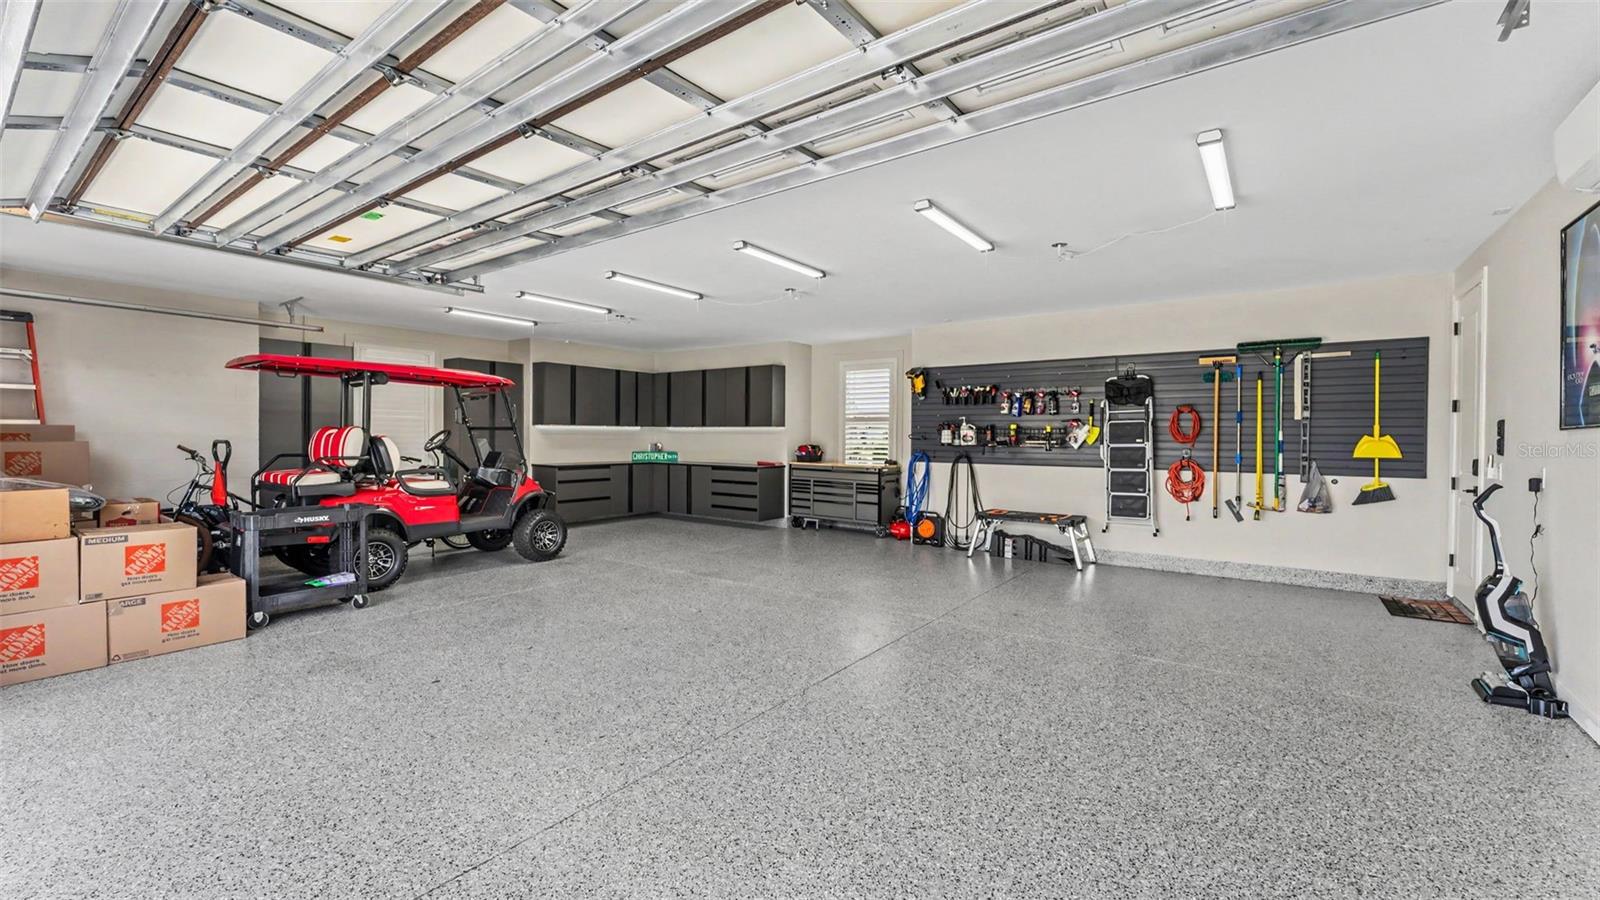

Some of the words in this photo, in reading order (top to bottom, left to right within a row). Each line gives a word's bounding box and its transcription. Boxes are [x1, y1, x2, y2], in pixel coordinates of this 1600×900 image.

[632, 452, 668, 460] CHRISTOPHER
[304, 515, 330, 523] HUSKY
[88, 536, 125, 544] MEDIUM
[125, 544, 163, 576] HOME
[142, 554, 165, 574] DEPOT
[10, 569, 38, 590] DEPOT
[120, 599, 143, 608] ARGE
[162, 600, 198, 632] HOME
[177, 609, 199, 630] DEPOT
[0, 625, 43, 662] HOME
[16, 636, 44, 658] DEPOT
